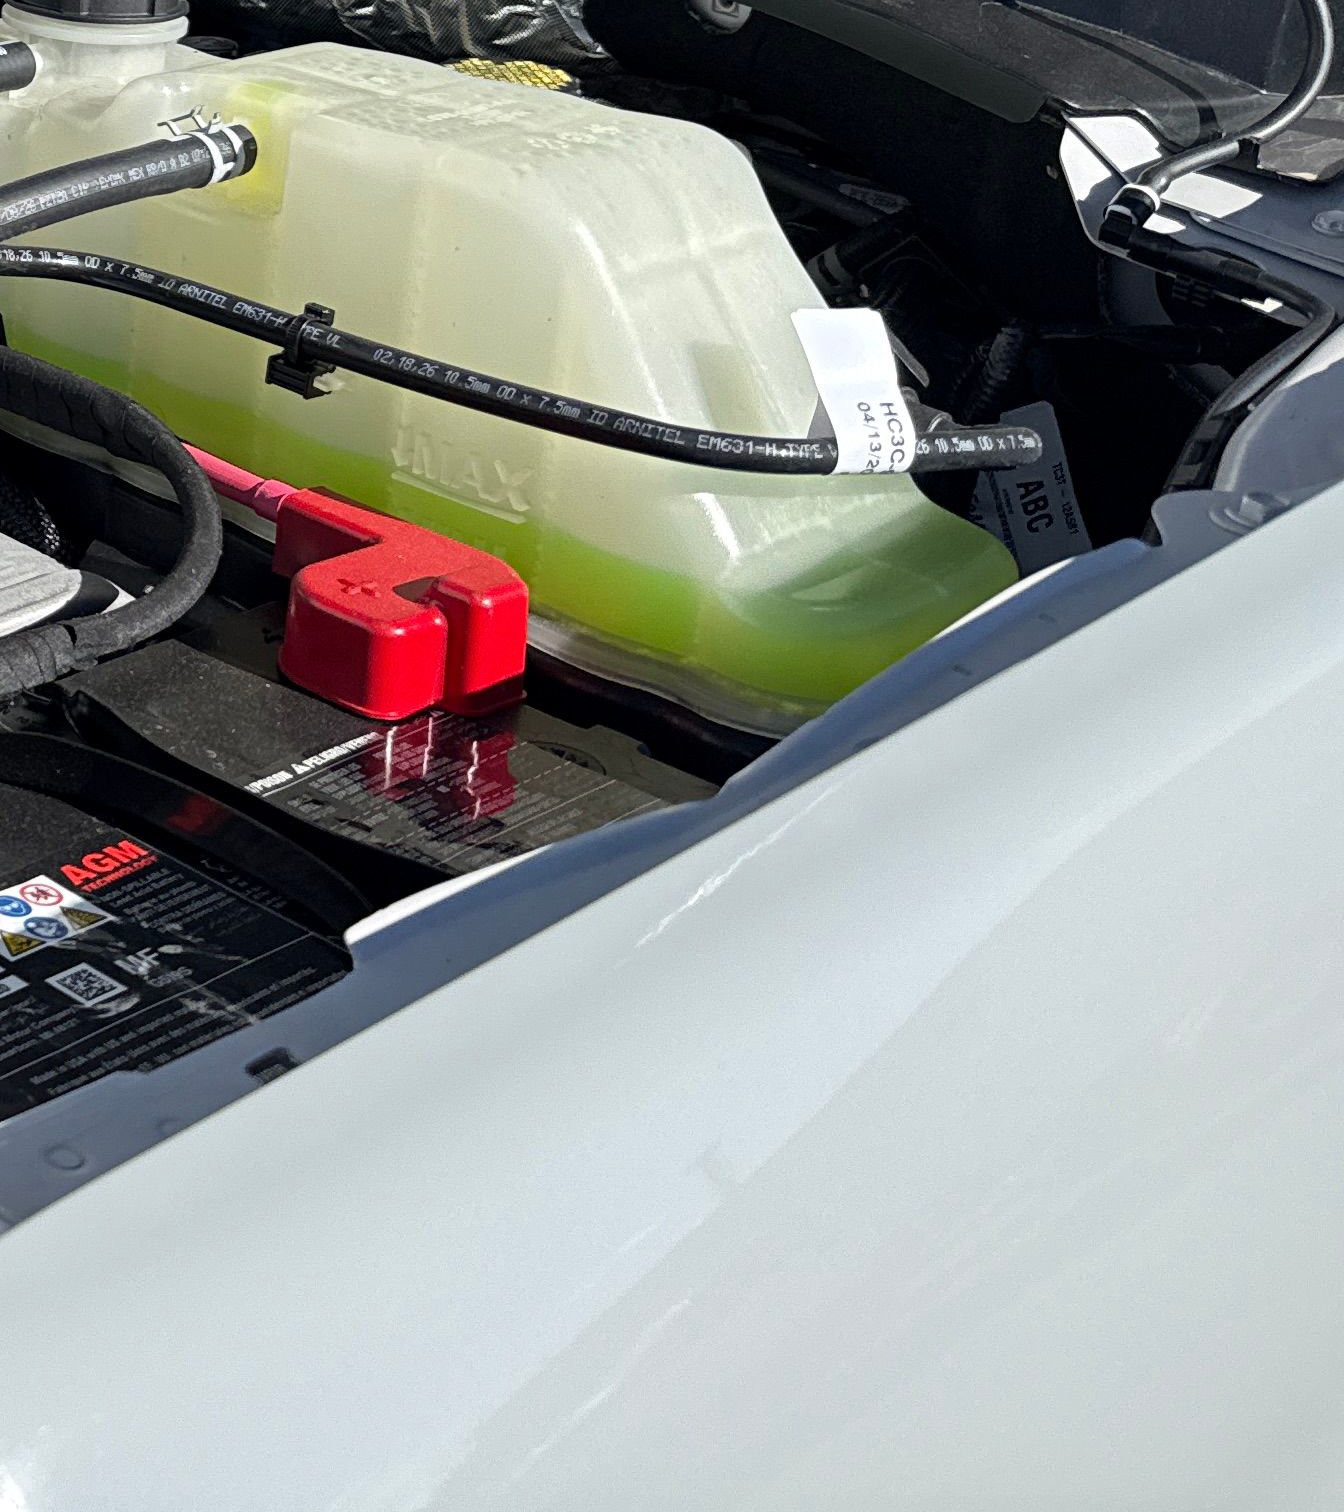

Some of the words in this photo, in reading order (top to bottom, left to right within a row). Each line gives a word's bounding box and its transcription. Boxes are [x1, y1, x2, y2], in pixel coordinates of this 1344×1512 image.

[519, 393, 530, 406] x
[612, 415, 686, 446] ARNITEL
[411, 432, 536, 513] MAX
[1016, 480, 1054, 534] ABC
[60, 838, 149, 886] AGM
[81, 854, 158, 893] TECHNOLOGY
